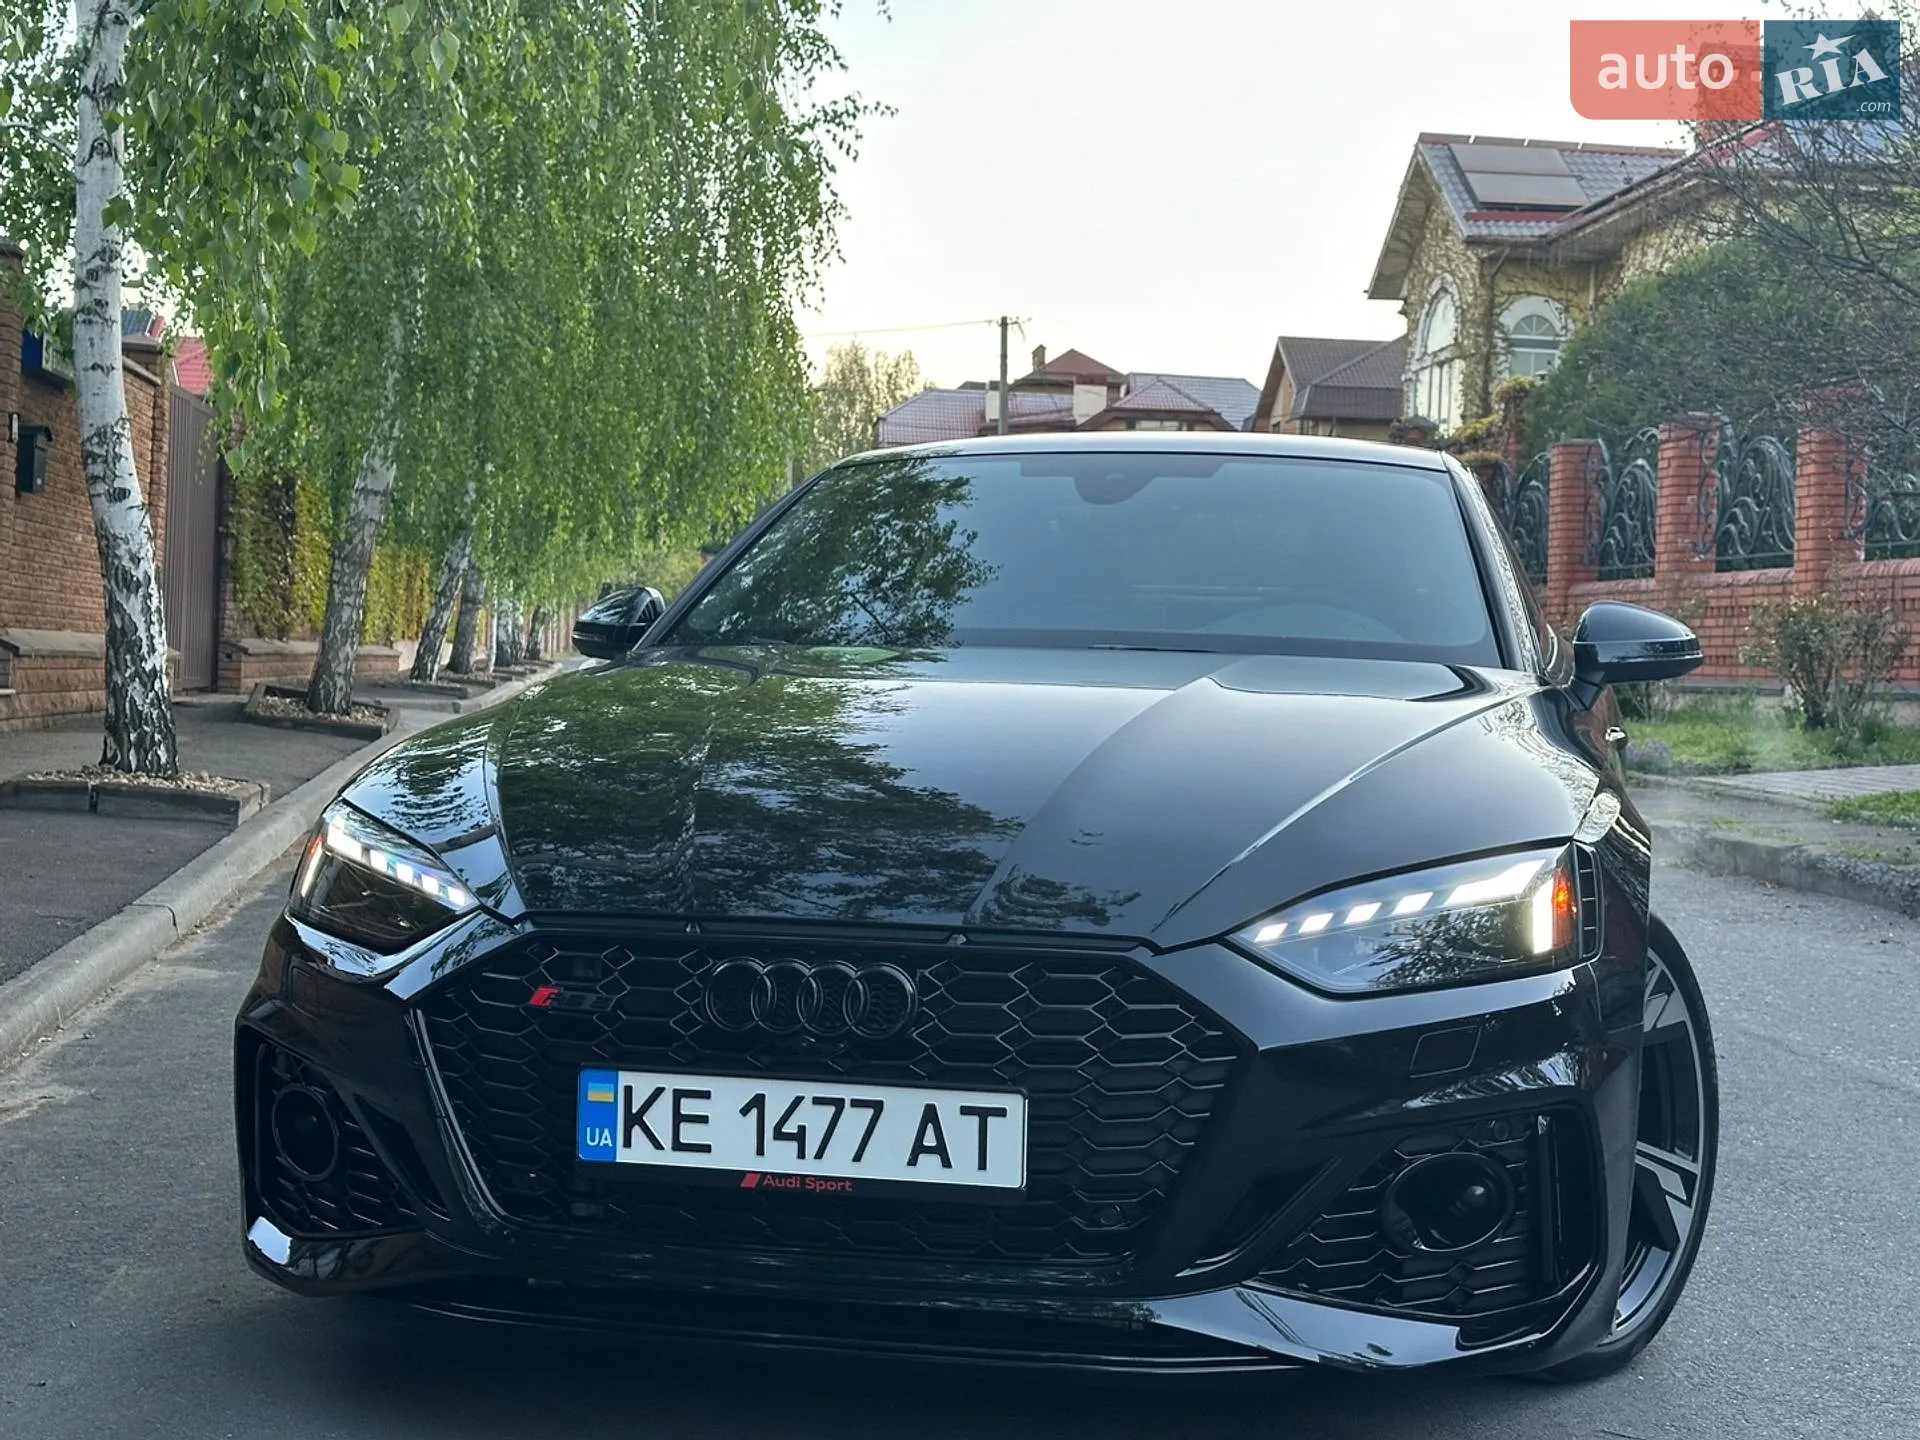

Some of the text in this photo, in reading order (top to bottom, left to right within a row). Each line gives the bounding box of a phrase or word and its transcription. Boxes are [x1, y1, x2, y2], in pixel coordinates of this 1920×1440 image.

[586, 1127, 612, 1147] UA
[622, 1085, 1007, 1171] KE 1477 AT
[763, 1175, 853, 1192] Audi Sport
